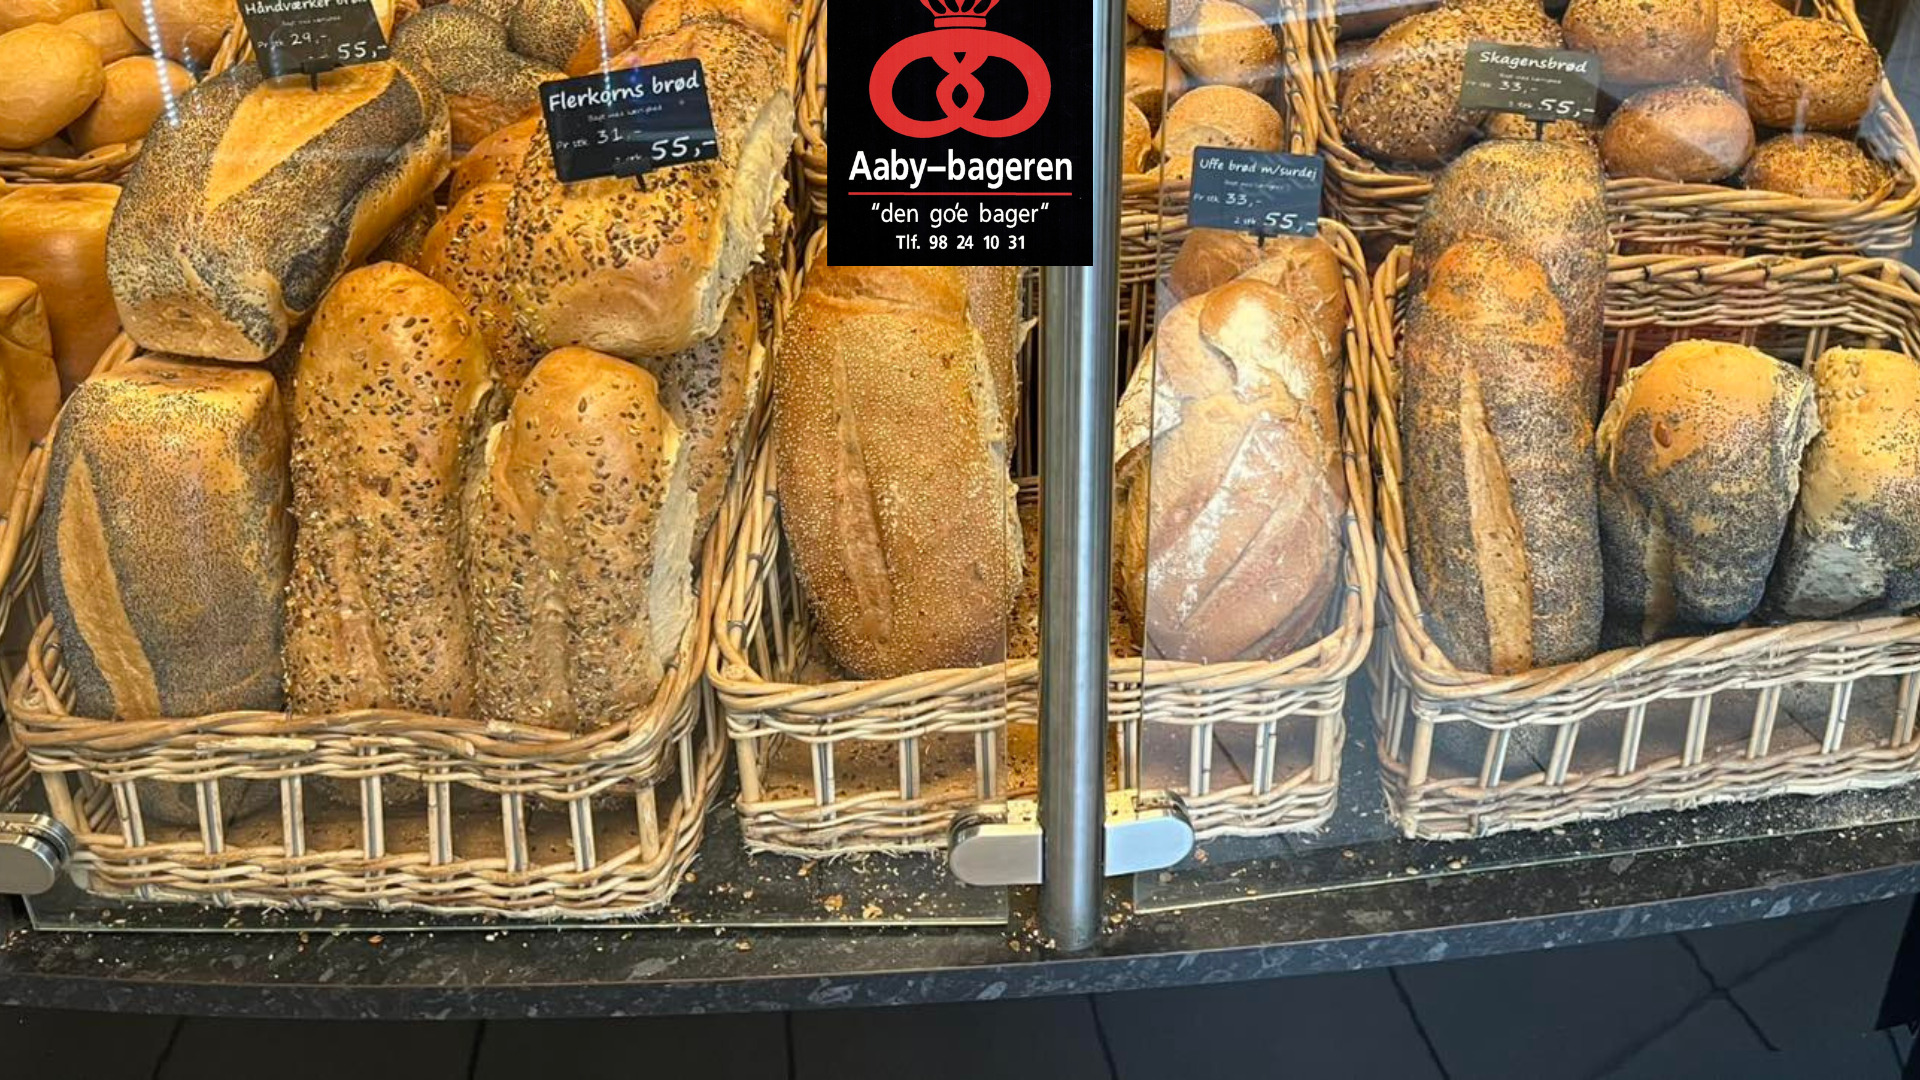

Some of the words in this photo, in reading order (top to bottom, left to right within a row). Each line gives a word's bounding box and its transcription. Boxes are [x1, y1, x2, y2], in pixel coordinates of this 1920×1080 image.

[337, 41, 388, 60] 55,-
[1479, 51, 1588, 73] Skagensbrød
[549, 83, 645, 112] Flerkorns
[652, 70, 700, 95] brød
[1499, 81, 1538, 94] 33,-
[1538, 98, 1595, 117] 55,-
[652, 136, 716, 160] 55,-
[1200, 158, 1224, 170] Uffe
[1228, 160, 1257, 173] brød
[1261, 165, 1318, 181] m/surdej
[1225, 193, 1262, 208] 33,-
[1263, 212, 1317, 233] 55,-
